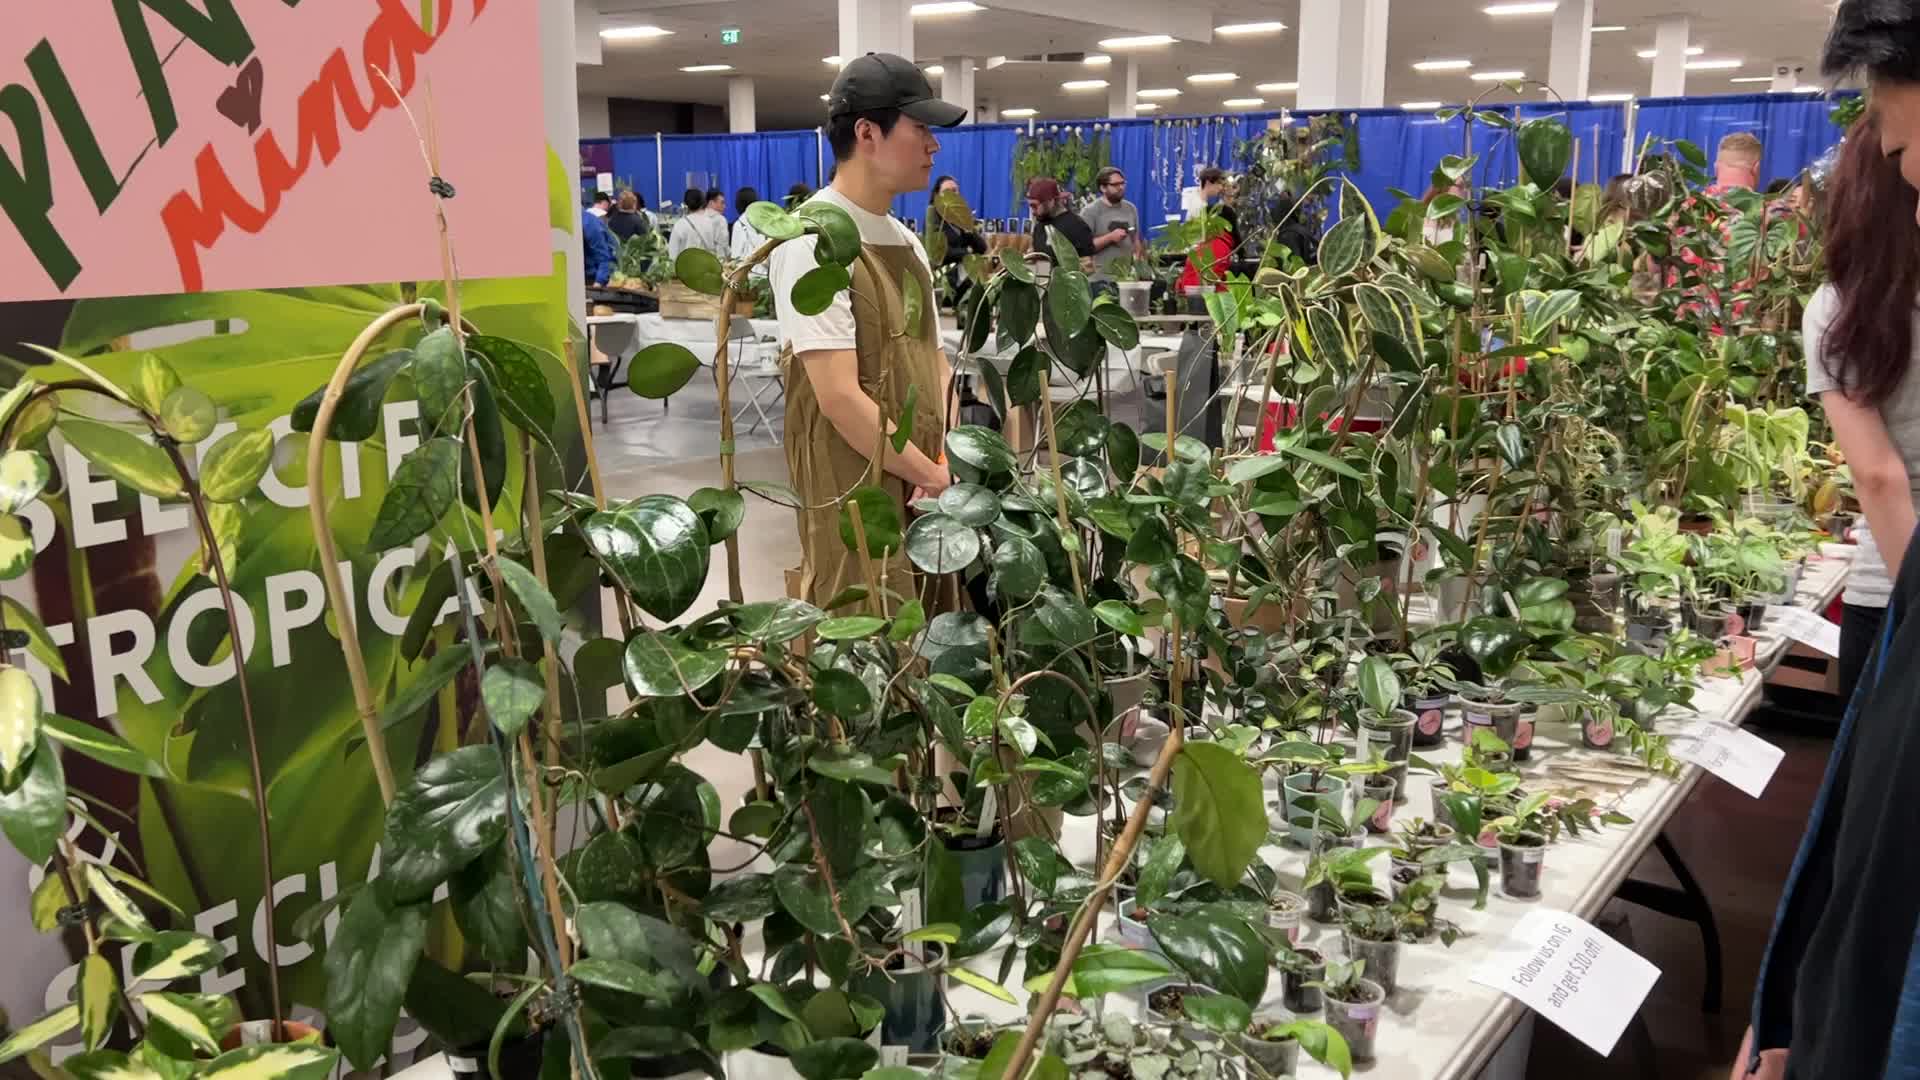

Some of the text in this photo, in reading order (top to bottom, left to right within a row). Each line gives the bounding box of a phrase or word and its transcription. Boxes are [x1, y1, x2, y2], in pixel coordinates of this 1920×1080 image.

[1511, 922, 1571, 988] Follow us on IG
[1568, 952, 1592, 975] $10
[1561, 970, 1580, 992] get
[1547, 983, 1568, 1008] and
